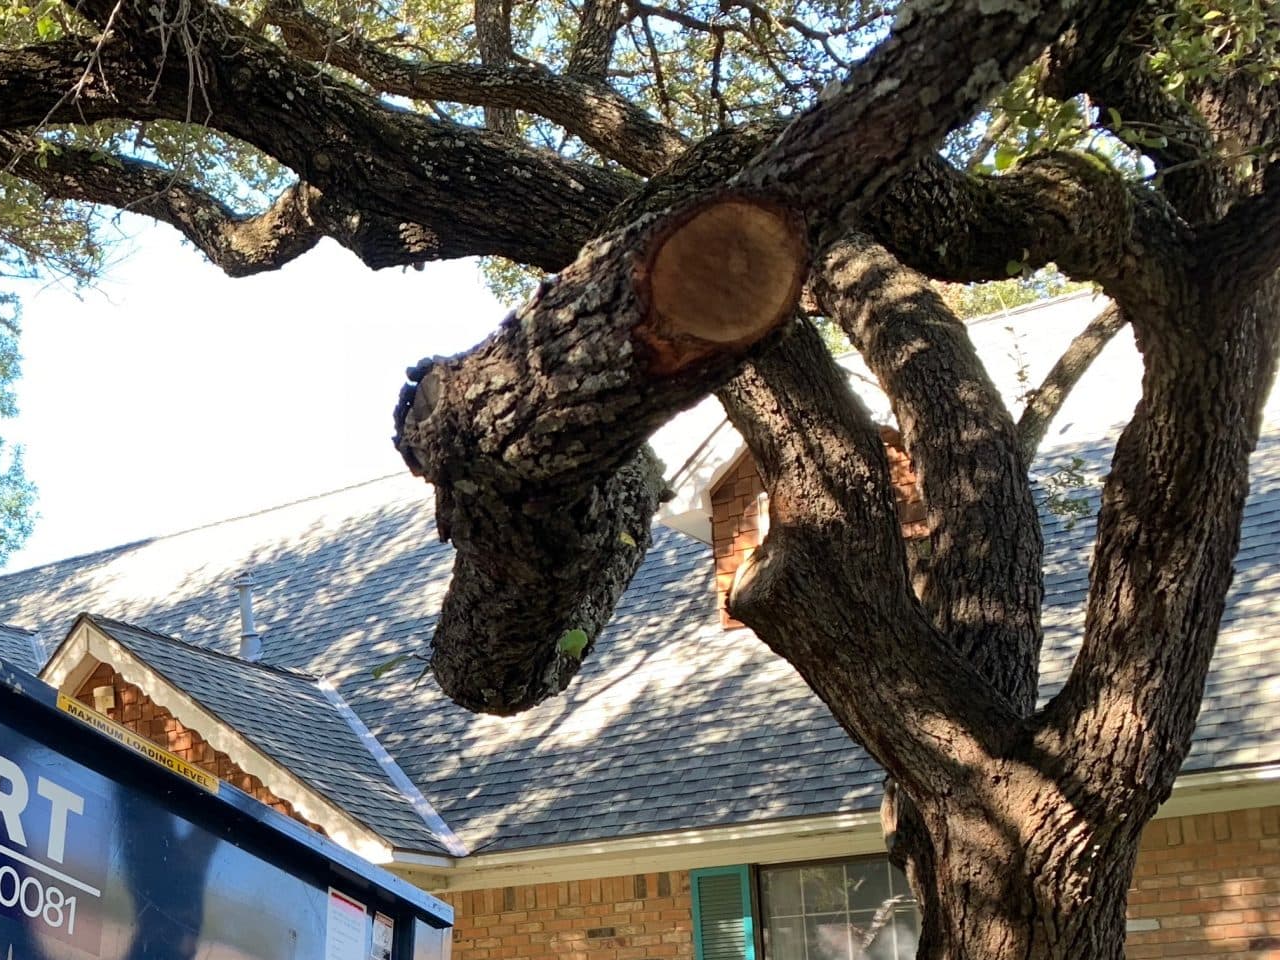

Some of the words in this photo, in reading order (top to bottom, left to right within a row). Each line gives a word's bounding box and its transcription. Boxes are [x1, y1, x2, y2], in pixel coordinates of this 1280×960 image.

[67, 704, 125, 741] MAXIMUM
[126, 736, 174, 768] LOADING
[177, 763, 210, 787] LEVEL
